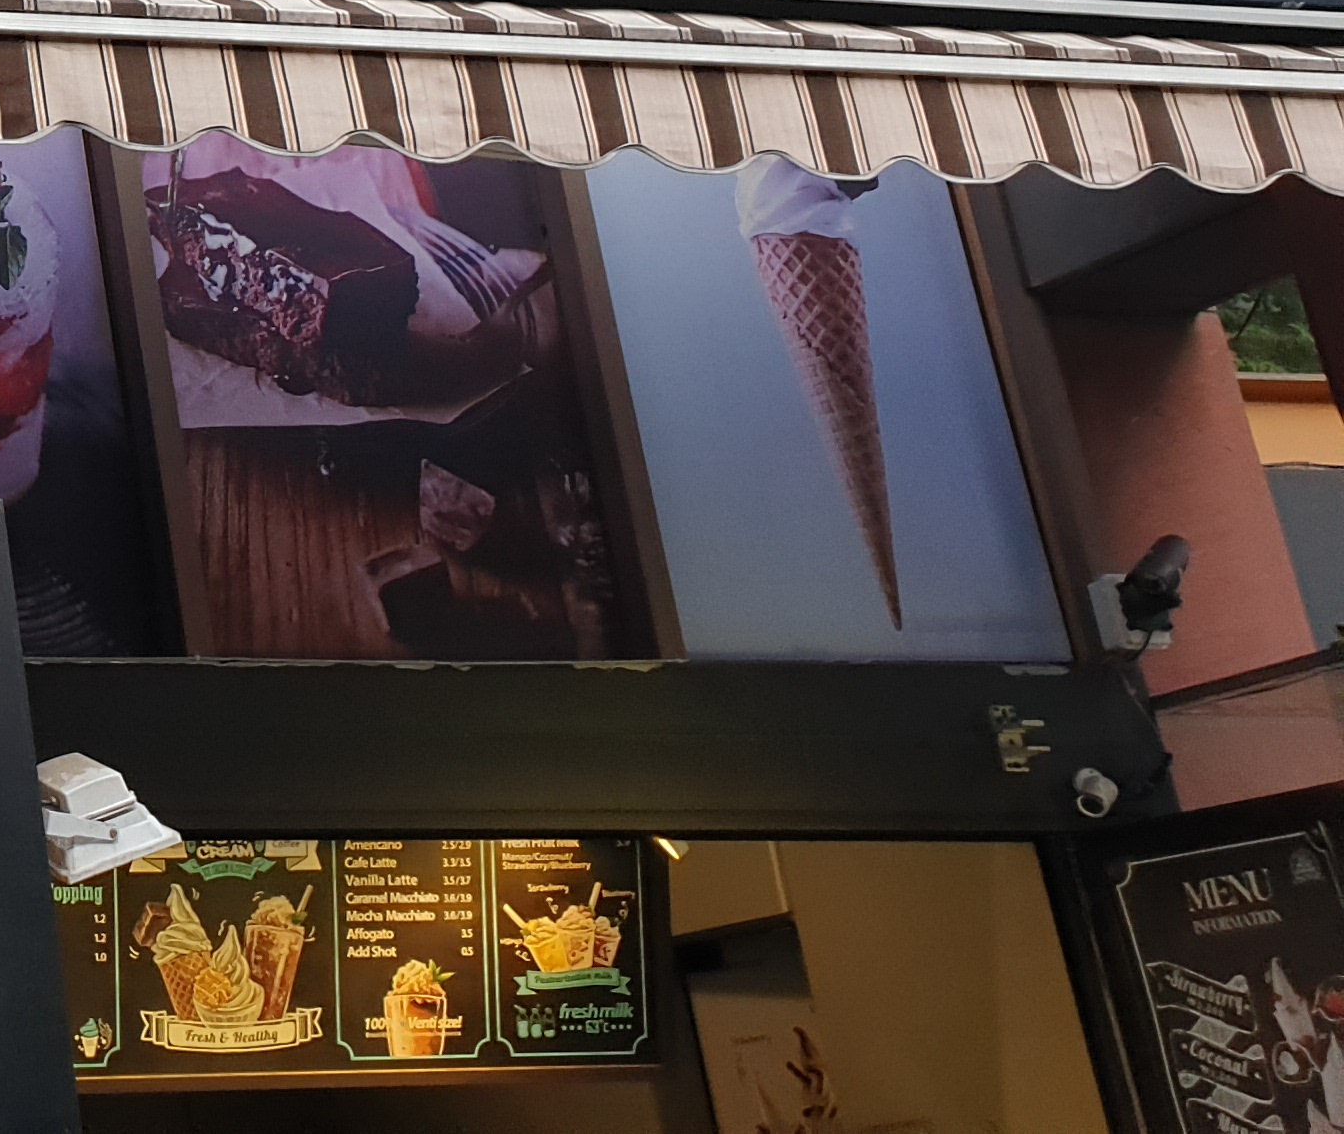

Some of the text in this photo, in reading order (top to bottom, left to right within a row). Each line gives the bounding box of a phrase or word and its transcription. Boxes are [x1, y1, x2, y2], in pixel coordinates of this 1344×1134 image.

[196, 843, 255, 859] CREAM
[344, 857, 397, 868] Cafe Latte
[344, 874, 419, 886] Vanilla Latte
[51, 883, 103, 906] opping
[1182, 867, 1274, 913] MENU
[345, 892, 440, 904] Caramel Macchiato
[346, 910, 436, 922] Mocha Macchiato
[346, 928, 395, 942] Affogato
[346, 946, 397, 958] Add Shot
[559, 1002, 598, 1019] fresh
[408, 1017, 437, 1029] Venti
[185, 1029, 279, 1043] Fresh & Healthy
